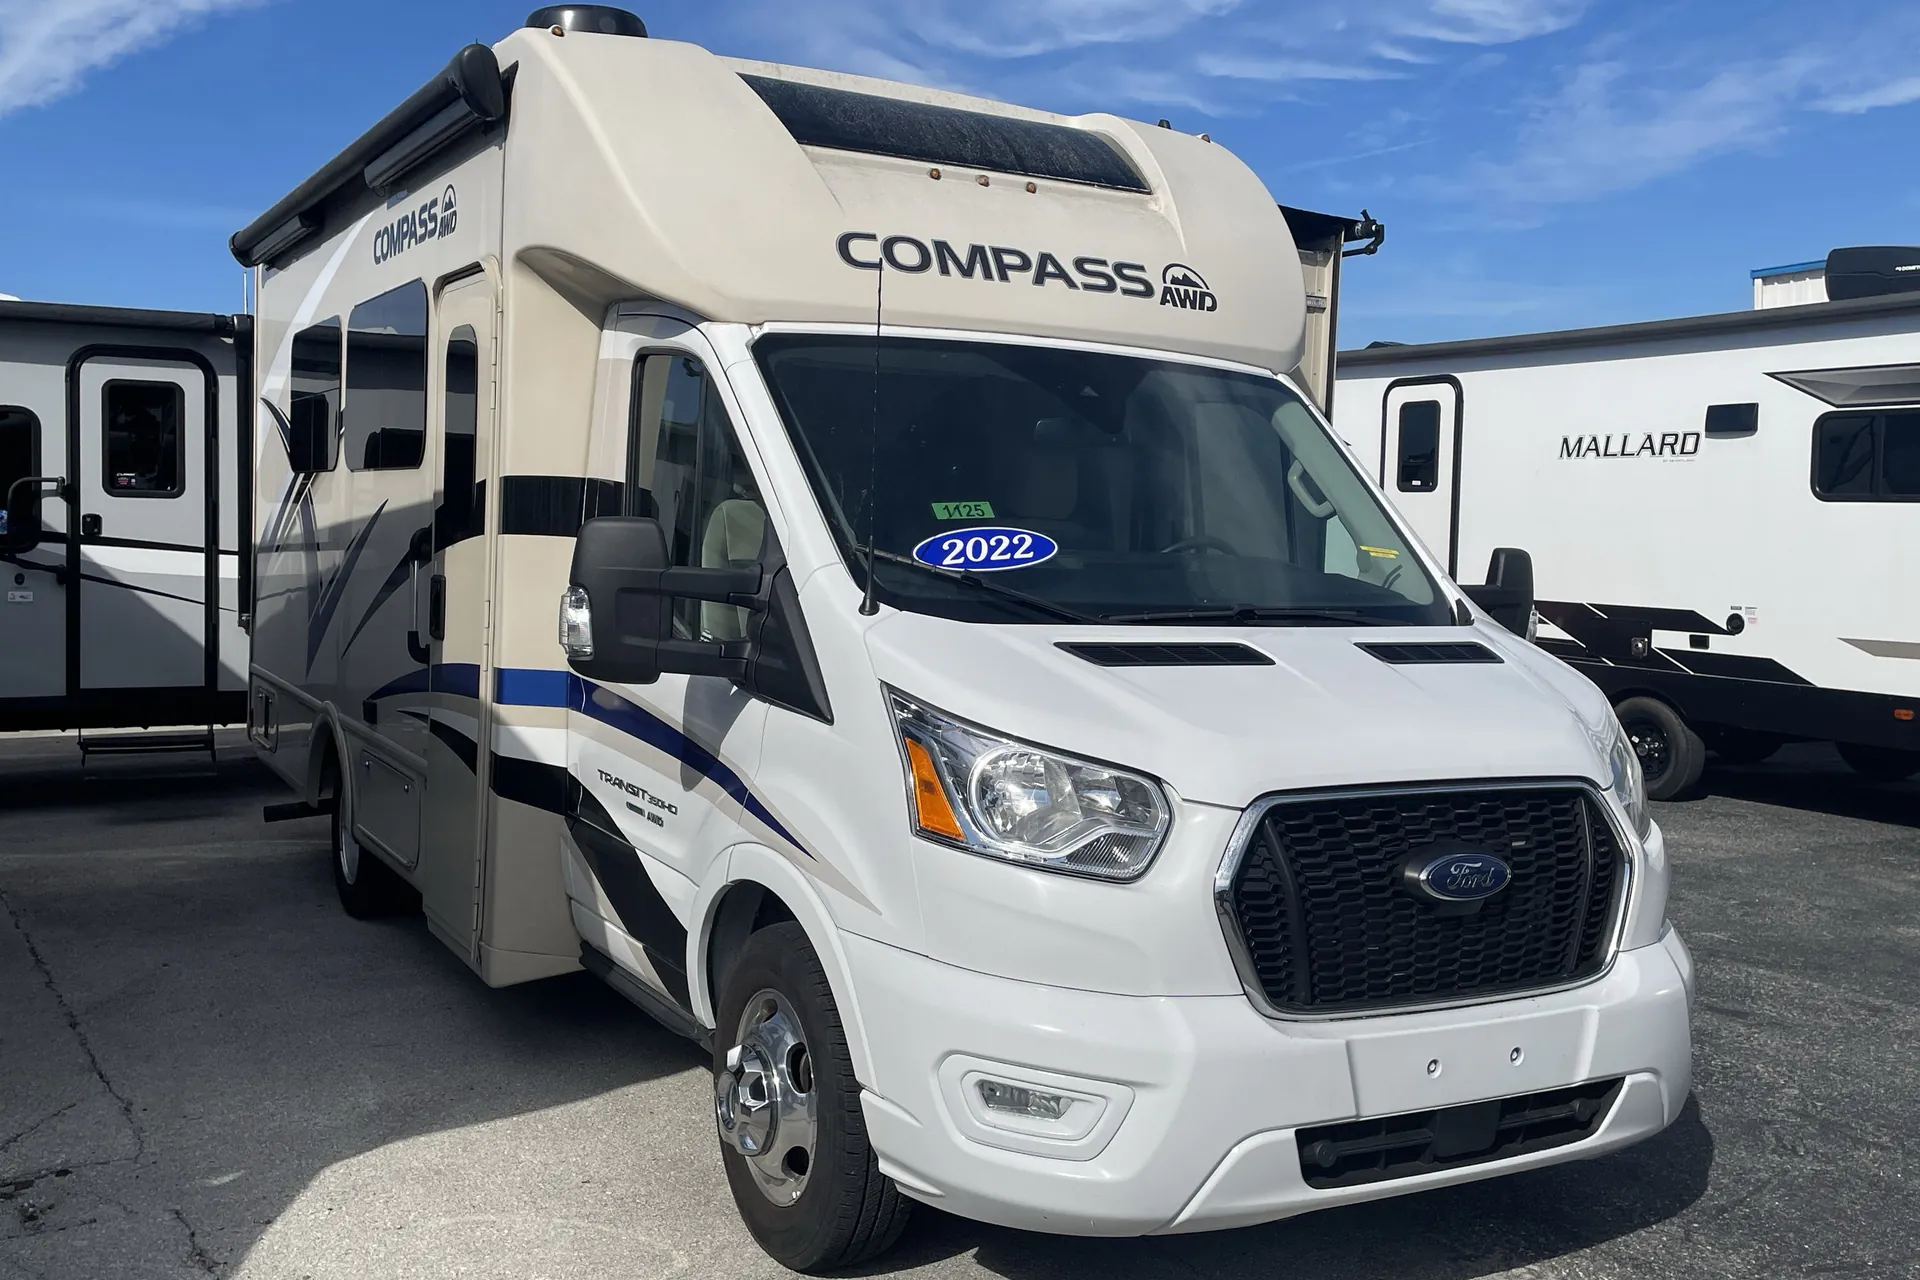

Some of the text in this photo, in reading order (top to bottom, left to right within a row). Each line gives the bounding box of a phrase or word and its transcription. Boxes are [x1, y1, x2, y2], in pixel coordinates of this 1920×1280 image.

[373, 197, 457, 265] COMPASS AWD
[835, 231, 1218, 313] COMPASS AWD
[1558, 431, 1702, 460] MALLARD
[942, 503, 985, 518] 1125
[941, 534, 1034, 566] 2022
[597, 768, 648, 801] TRANSIT
[1447, 861, 1496, 890] Ford
